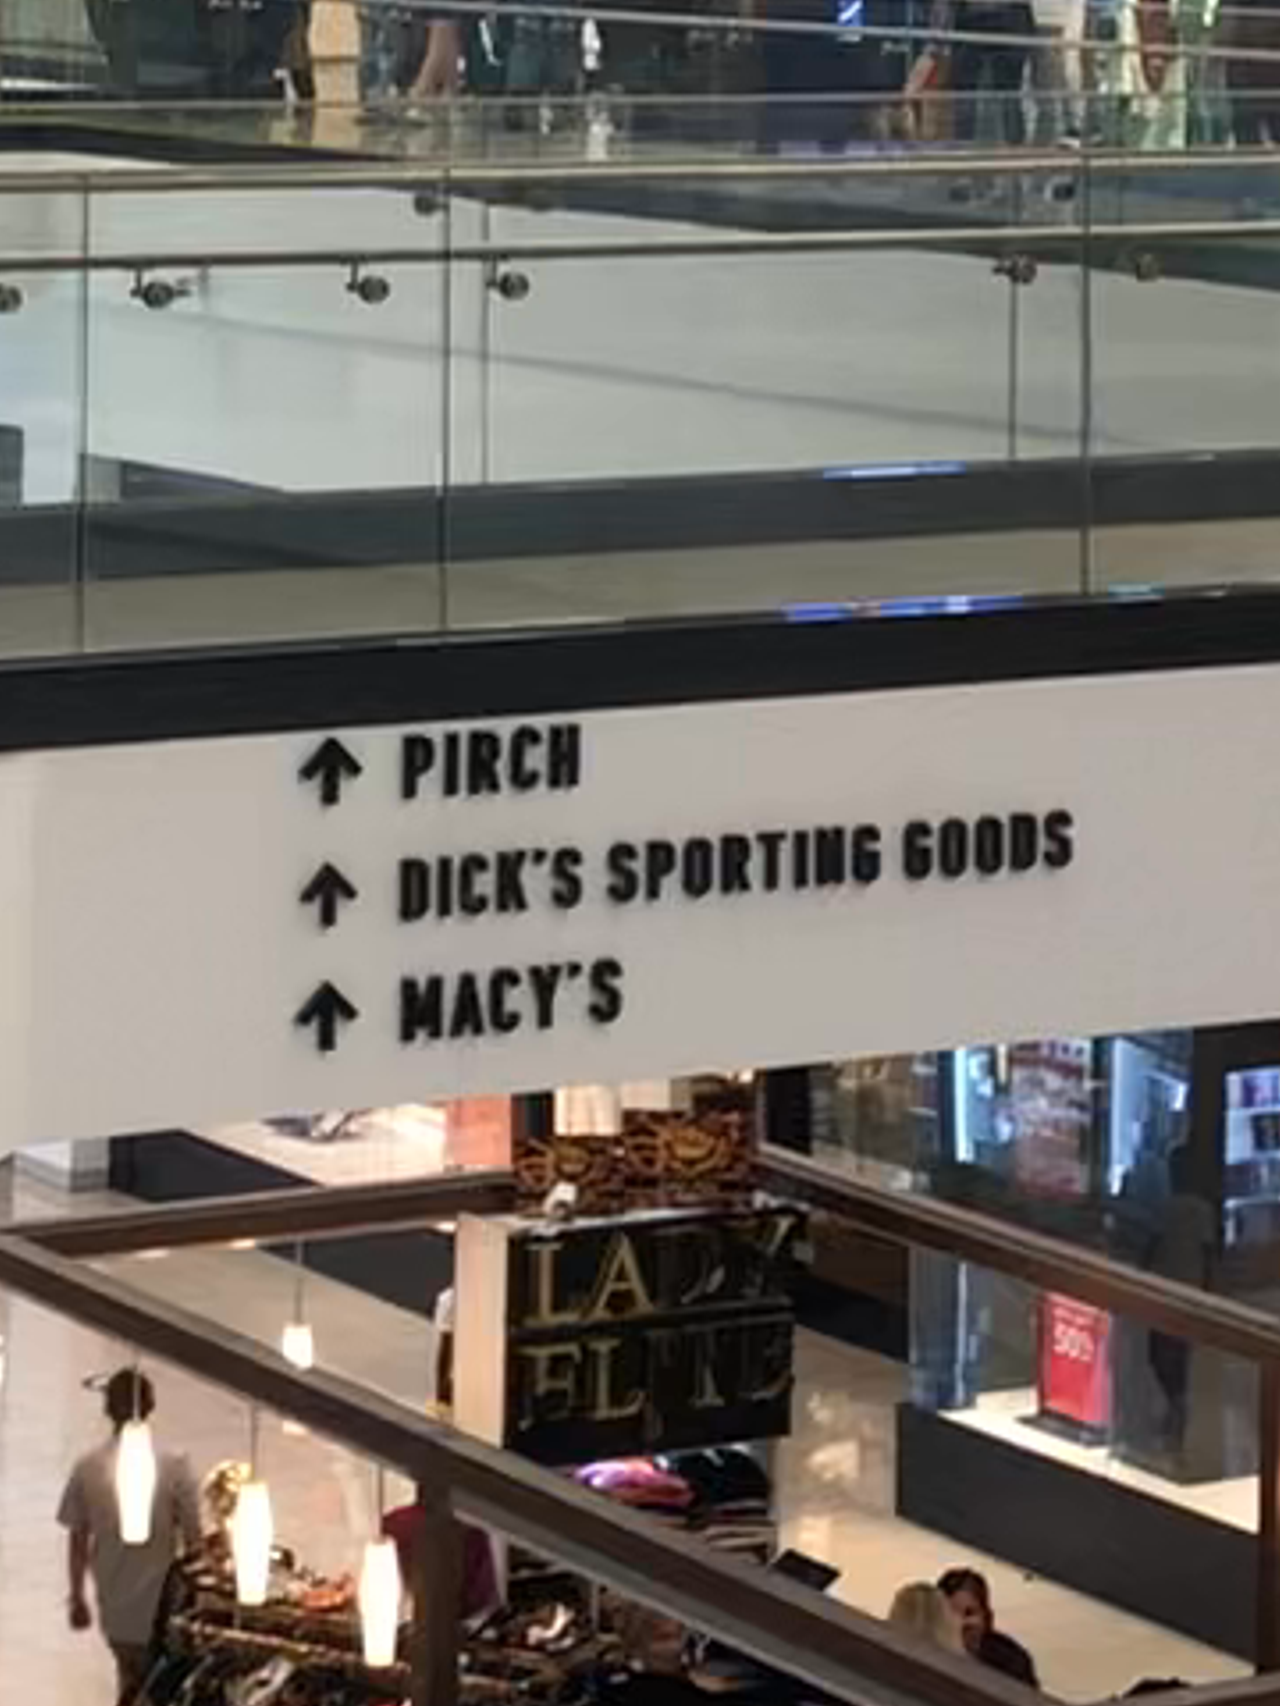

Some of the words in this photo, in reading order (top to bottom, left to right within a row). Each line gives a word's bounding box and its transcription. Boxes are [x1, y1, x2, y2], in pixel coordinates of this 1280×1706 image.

[401, 724, 581, 799] PIRCH
[398, 846, 583, 922] DICK'S
[606, 825, 883, 904] SPORTING
[903, 809, 1074, 882] GOODS
[399, 958, 624, 1043] MACY'S
